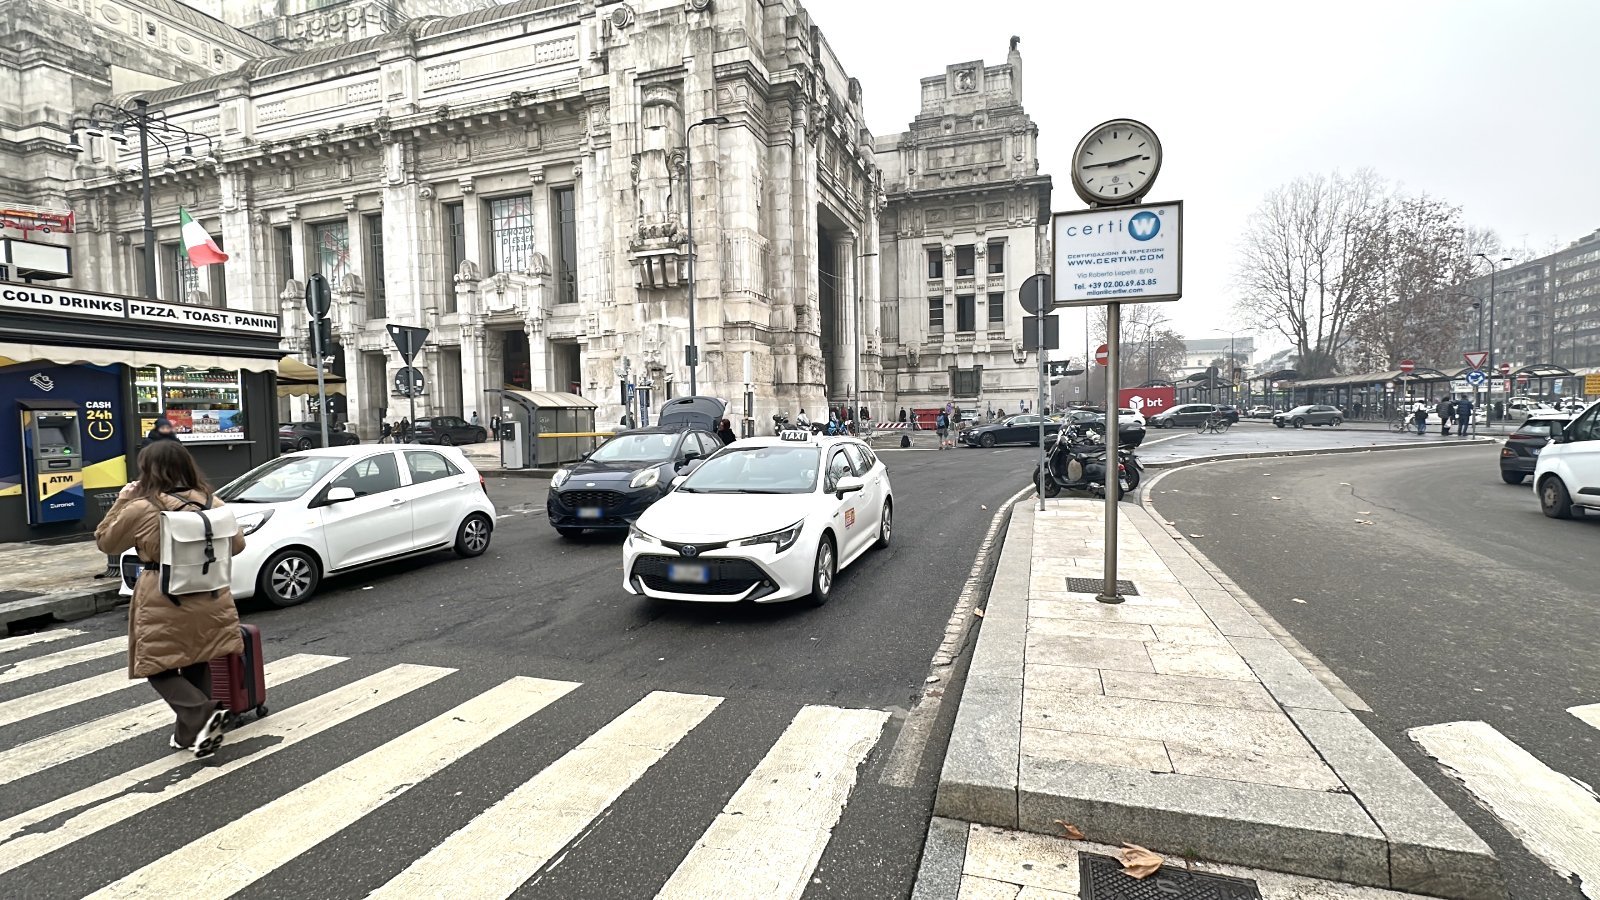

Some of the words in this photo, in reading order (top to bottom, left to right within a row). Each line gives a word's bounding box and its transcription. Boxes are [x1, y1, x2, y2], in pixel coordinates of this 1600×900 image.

[1067, 251, 1119, 259] CERTIFICAZIONI
[1129, 247, 1165, 255] ISPEZIONI
[1067, 253, 1164, 266] WWW.CERTIW.COM
[1088, 270, 1114, 278] Roberto
[1088, 281, 1102, 289] +39
[1103, 278, 1157, 288] 02.00.69.63.85
[2, 289, 54, 305] COLD
[59, 295, 123, 312] DRINKS
[130, 304, 179, 320] PIZZA,
[182, 309, 231, 325] TOAST,
[234, 315, 277, 329] PANINI
[85, 401, 112, 409] CASH
[1146, 397, 1163, 407] brt
[86, 410, 113, 420] 24h
[784, 431, 805, 440] TAXI
[49, 474, 74, 484] ATM
